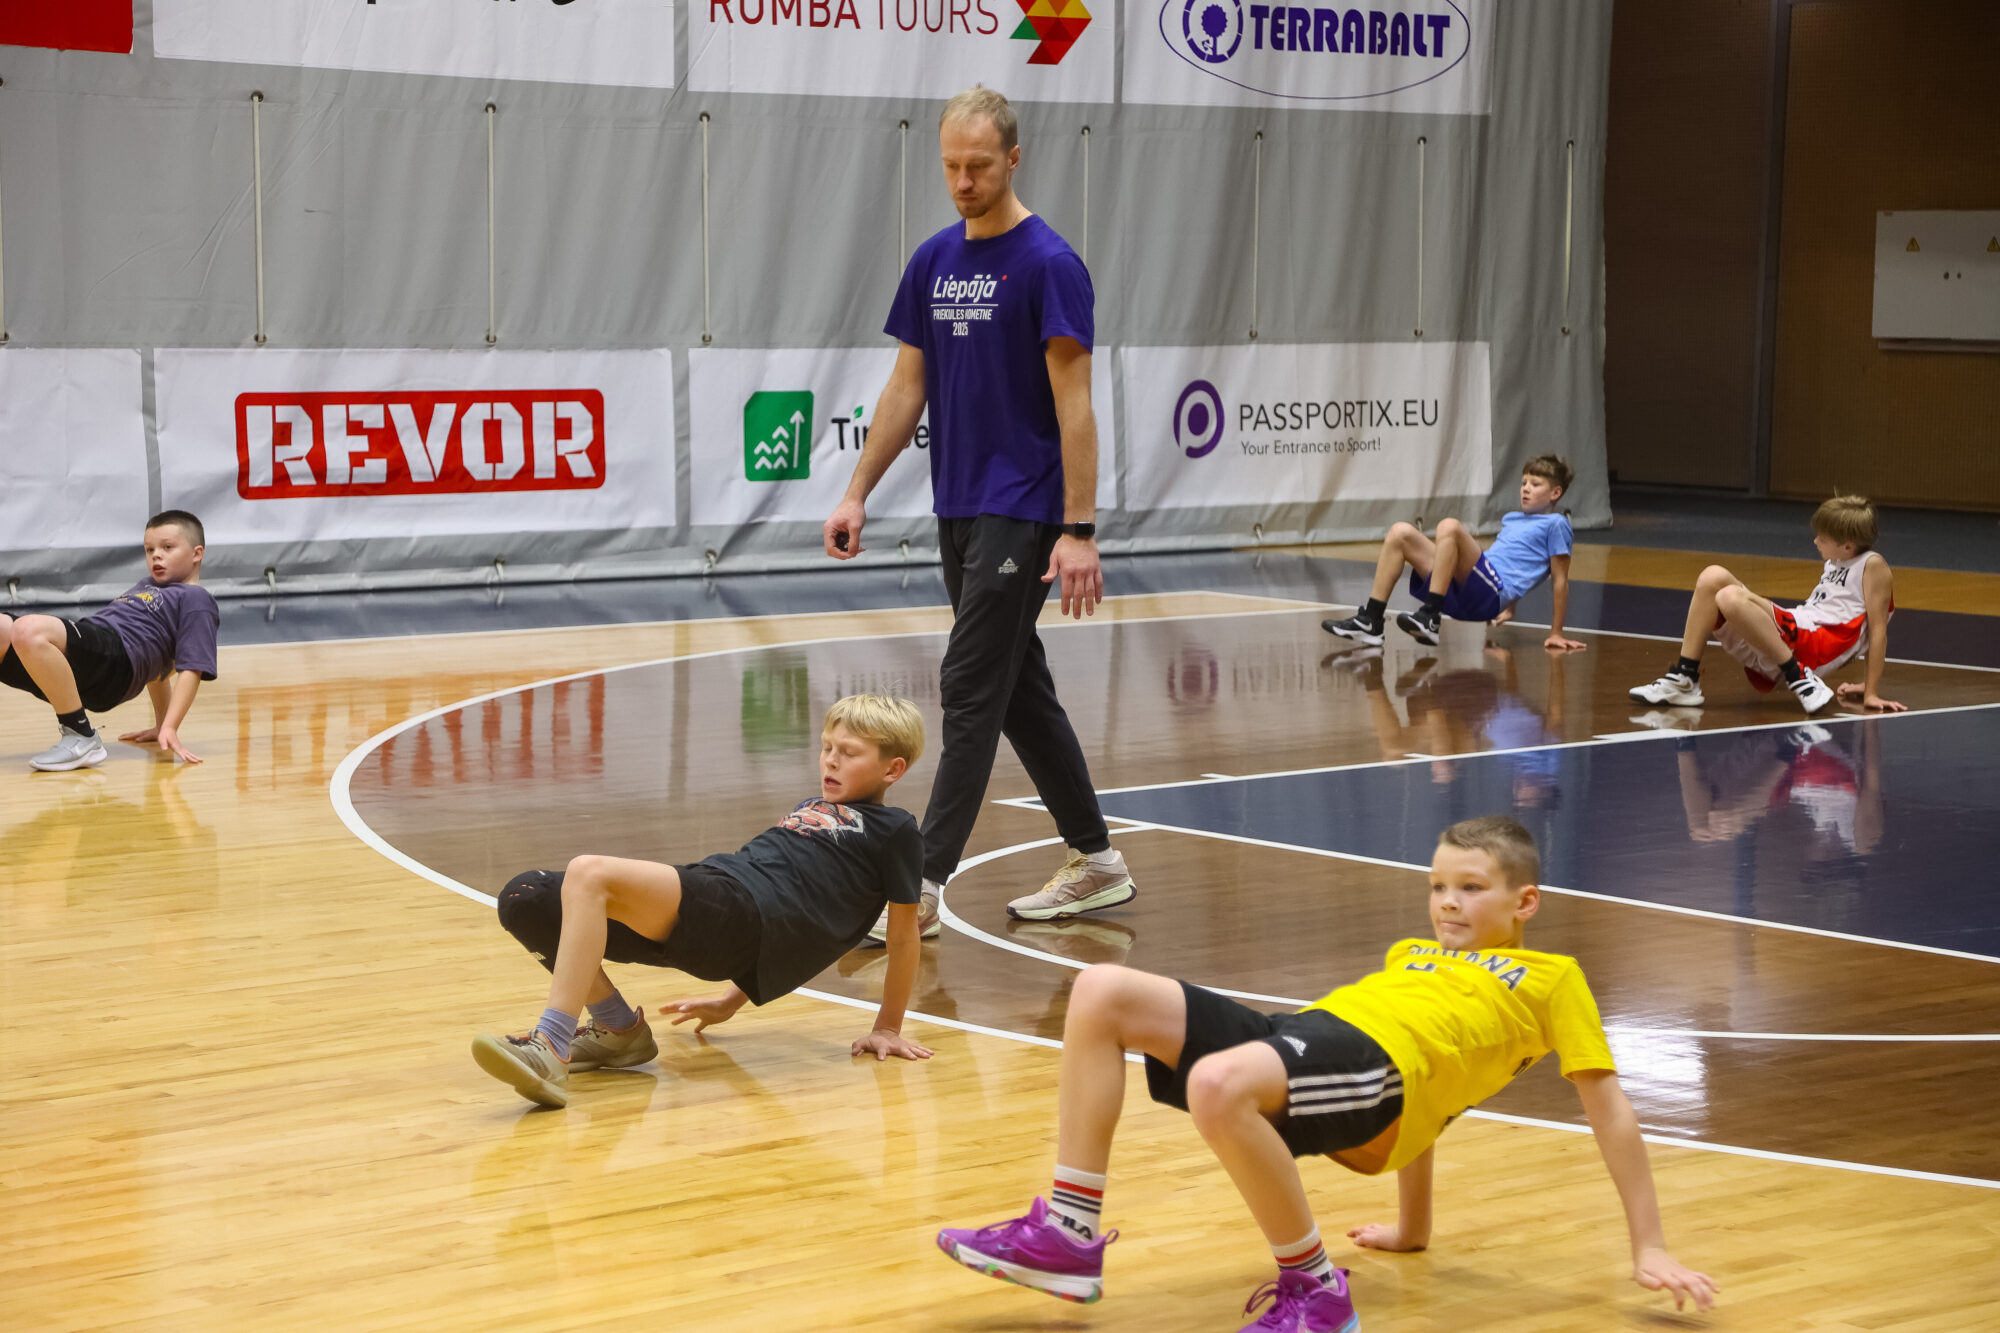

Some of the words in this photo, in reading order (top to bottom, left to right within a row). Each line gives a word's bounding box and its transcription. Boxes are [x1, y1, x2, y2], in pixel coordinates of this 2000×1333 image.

[1250, 5, 1451, 58] TERRABALT
[952, 321, 969, 336] 2025
[1239, 399, 1439, 431] PASSPORTIX.EU
[245, 401, 597, 487] REVOR
[1240, 439, 1269, 455] Your
[1273, 439, 1331, 454] Entrance
[1334, 441, 1345, 452] to
[1347, 437, 1381, 456] Sport!
